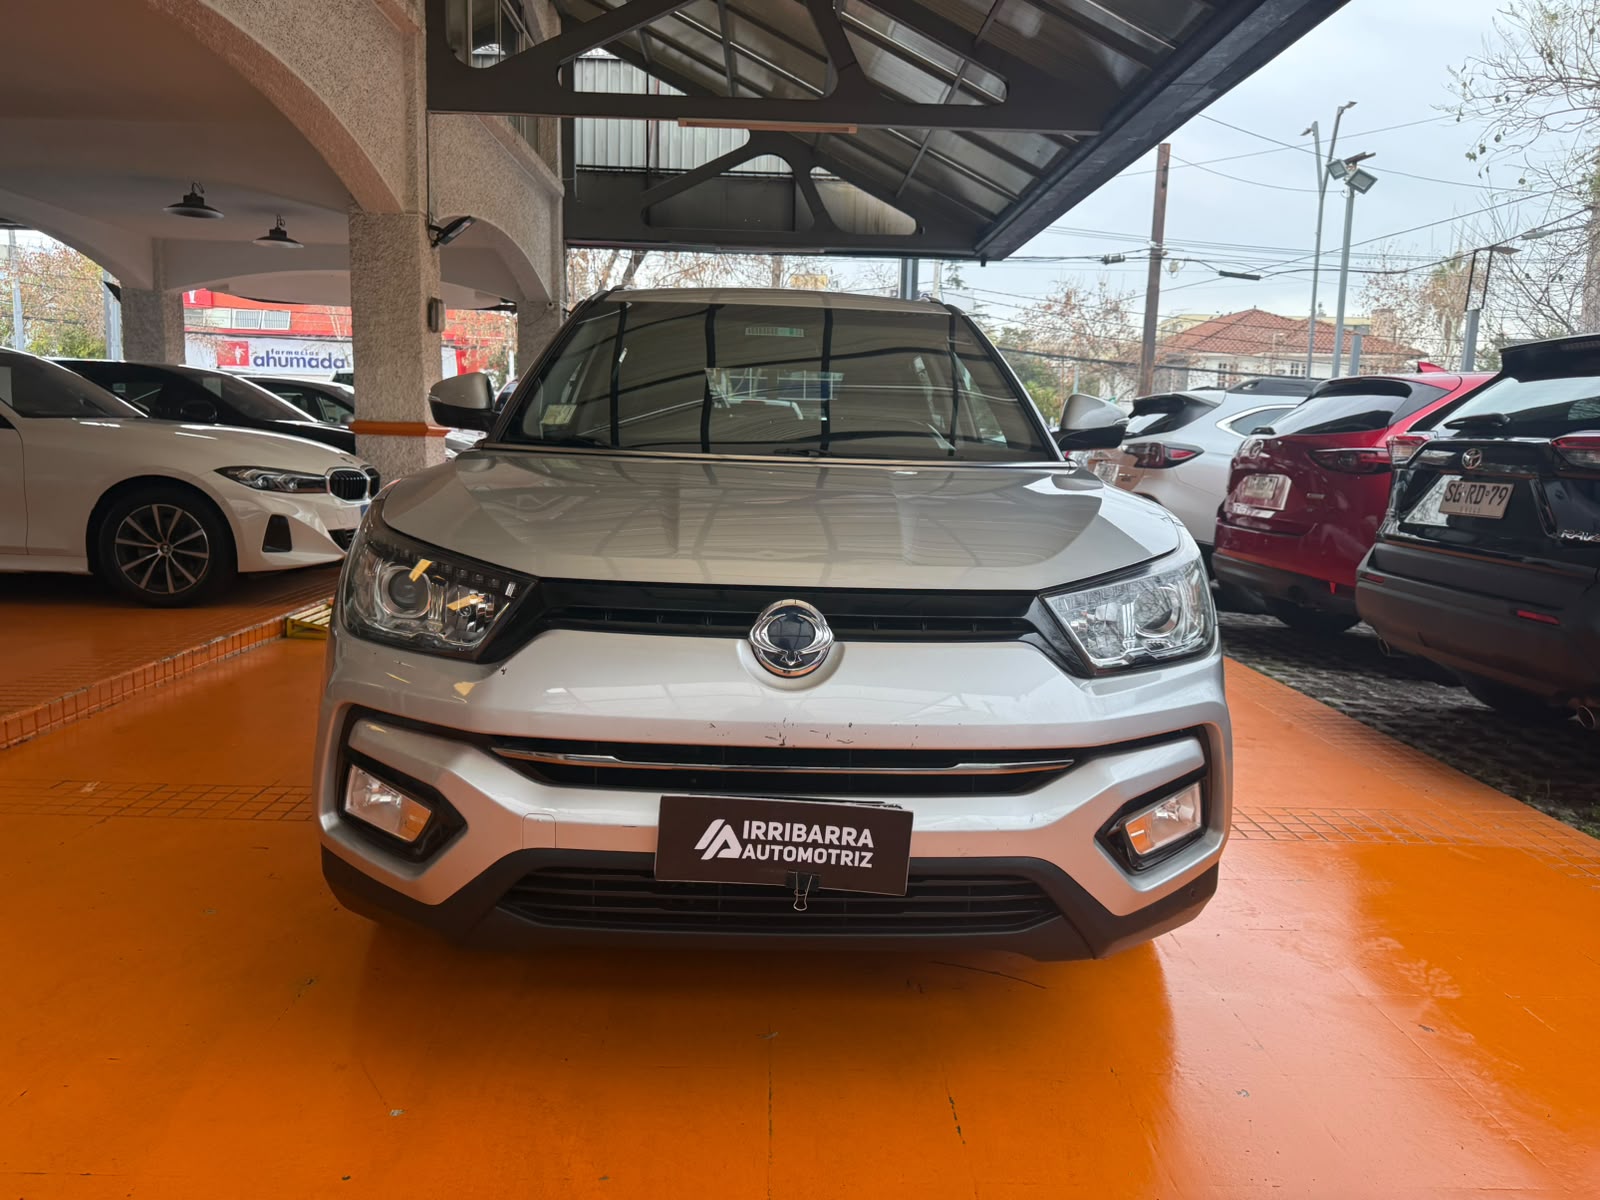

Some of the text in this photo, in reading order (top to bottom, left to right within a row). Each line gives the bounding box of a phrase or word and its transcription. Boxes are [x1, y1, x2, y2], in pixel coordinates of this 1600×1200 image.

[253, 350, 345, 369] ahumada
[271, 348, 319, 356] farmacias
[743, 820, 874, 848] IRRIBARRA
[742, 843, 874, 868] AUTOMOTRIZ
